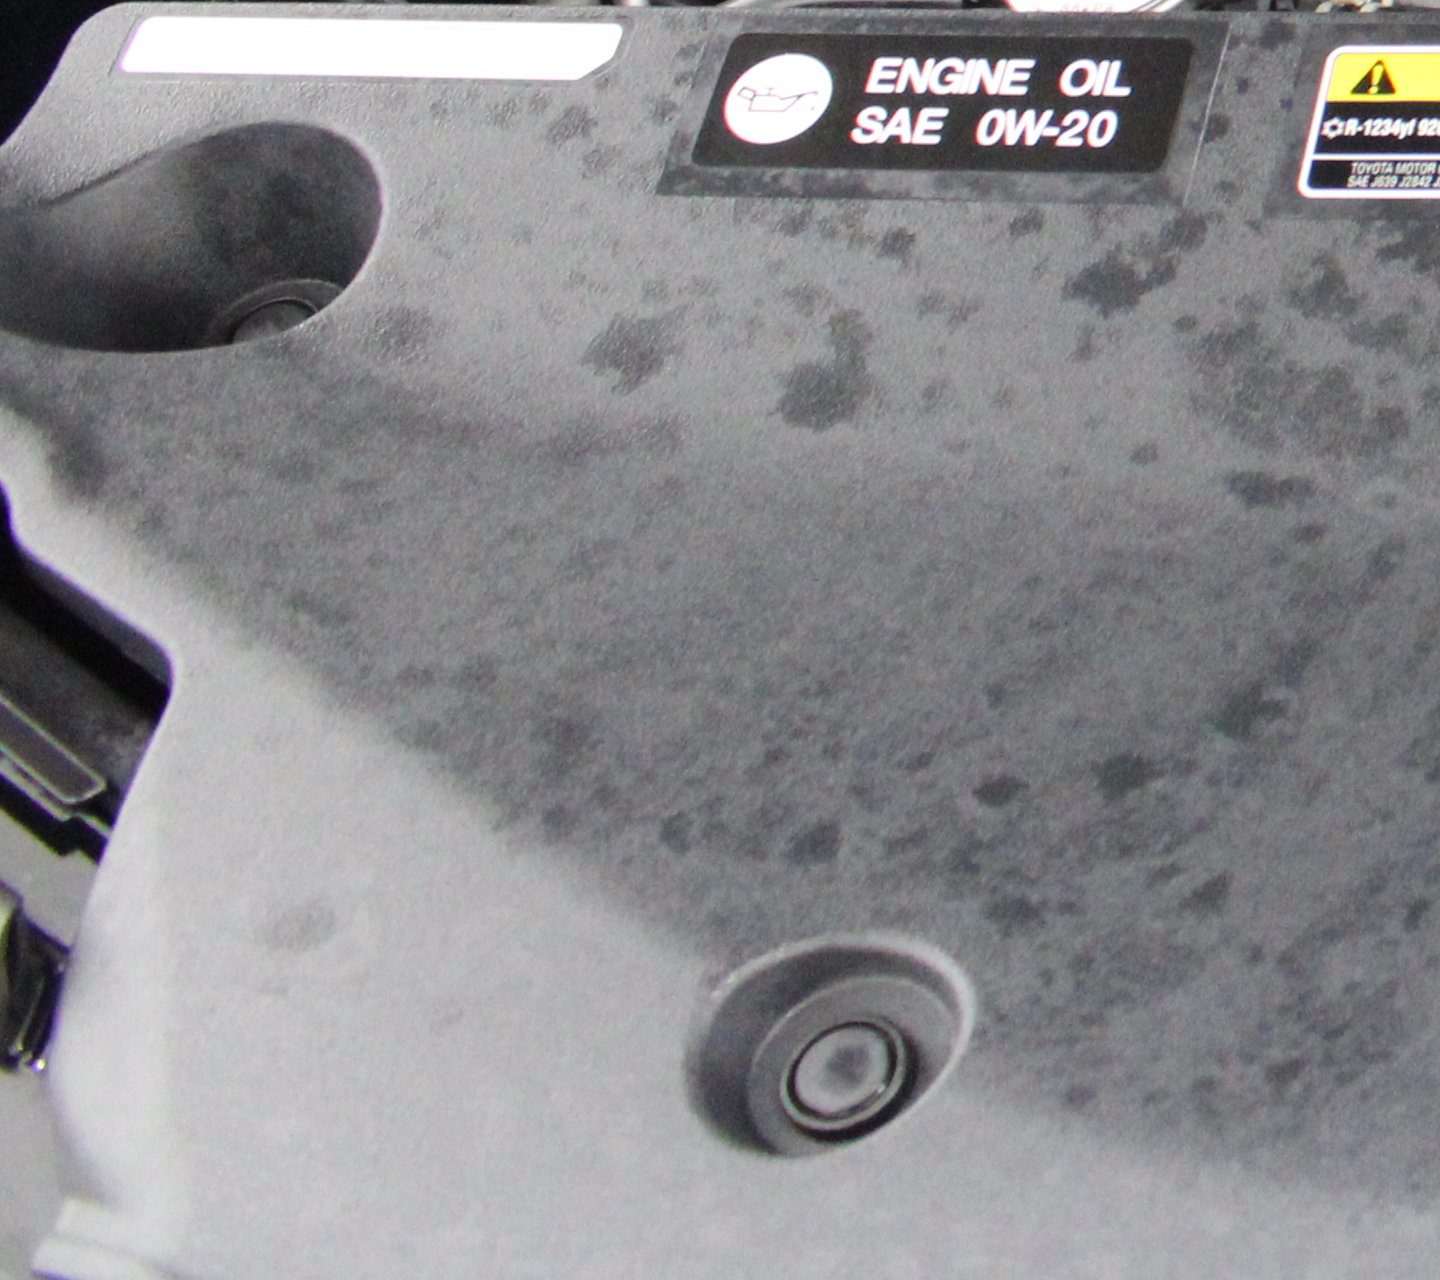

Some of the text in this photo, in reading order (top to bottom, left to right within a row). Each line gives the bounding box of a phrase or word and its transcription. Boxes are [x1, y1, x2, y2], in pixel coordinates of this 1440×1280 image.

[865, 56, 1132, 97] ENGINE OIL
[850, 106, 1118, 147] SAE 0W-20
[1343, 116, 1416, 140] R-1234yf
[1351, 161, 1395, 175] TOYOTA
[1395, 162, 1437, 175] MOTOR
[1347, 176, 1369, 187] SAE
